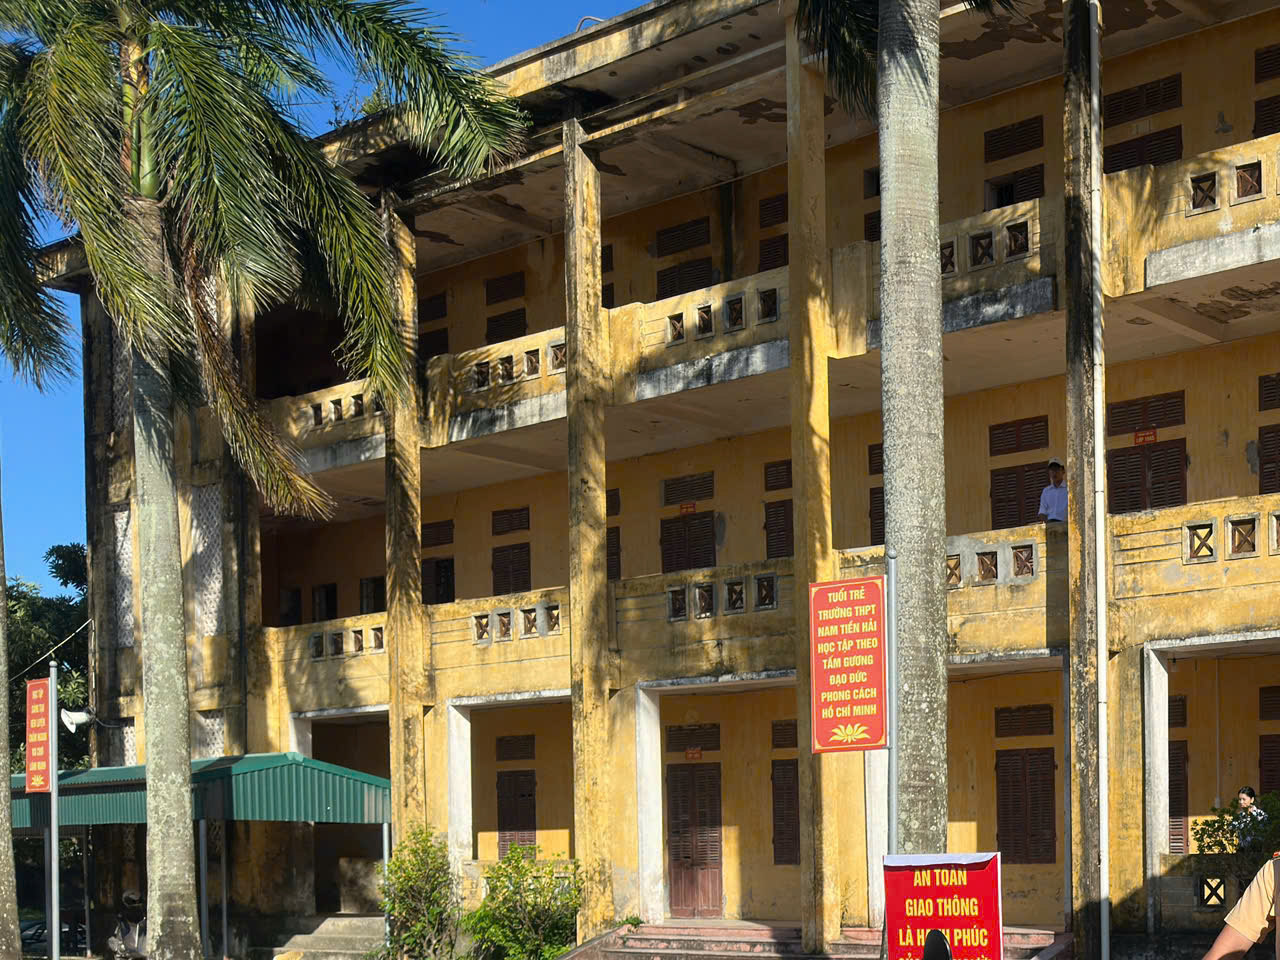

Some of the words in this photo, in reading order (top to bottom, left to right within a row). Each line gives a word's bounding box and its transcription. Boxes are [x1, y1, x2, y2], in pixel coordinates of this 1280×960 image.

[818, 606, 852, 621] TRƯỜNG
[854, 604, 876, 616] THPT
[817, 625, 838, 637] NAM
[862, 618, 877, 632] HẢI
[817, 641, 835, 655] HỌC
[837, 638, 854, 653] TẬP
[856, 637, 878, 650] THEO
[844, 655, 874, 668] GƯƠNG
[829, 674, 847, 687] ĐẠO
[821, 690, 851, 703] PHONG
[853, 687, 877, 699] CÁCH
[835, 704, 851, 718] CHÍ
[852, 704, 877, 717] MINH
[913, 869, 931, 887] AN
[933, 865, 968, 886] TOÀN
[905, 898, 934, 917] GIAO
[937, 894, 979, 917] THÔNG
[898, 924, 915, 947] LÀ
[954, 924, 989, 947] PHÚC
